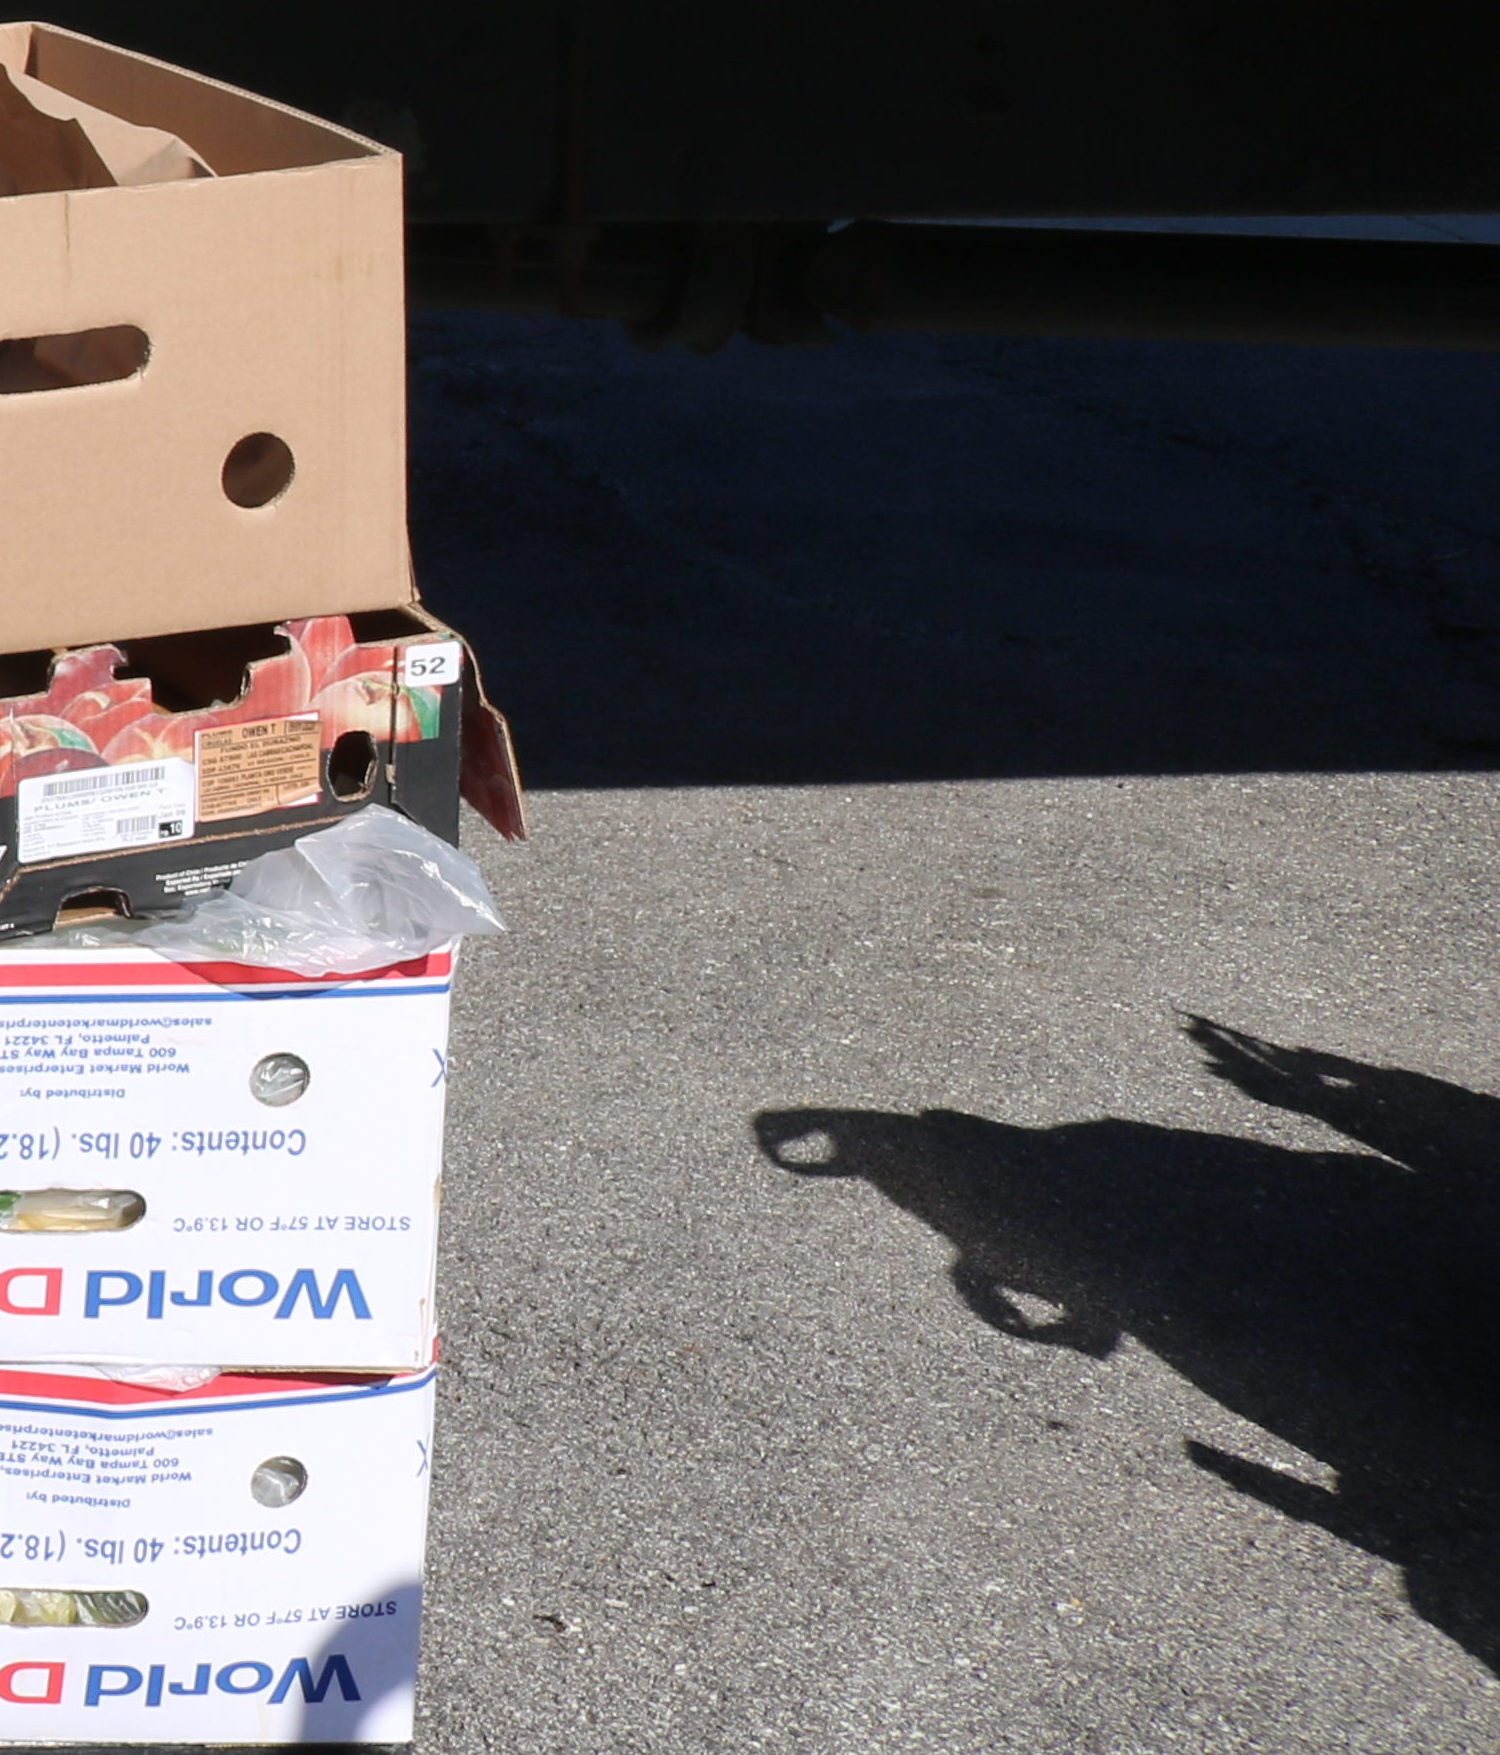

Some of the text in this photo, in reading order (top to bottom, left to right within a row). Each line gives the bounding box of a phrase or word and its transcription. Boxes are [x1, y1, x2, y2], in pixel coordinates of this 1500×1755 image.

[410, 655, 447, 678] 52
[241, 725, 268, 739] OWEN
[33, 797, 97, 813] PLUMS/
[100, 791, 151, 804] OWEN
[157, 787, 166, 795] T
[169, 821, 183, 834] 10
[4, 1033, 150, 1045] Palmetto, FL 34221
[25, 1046, 56, 1059] Way
[60, 1046, 89, 1058] Bay
[94, 1046, 144, 1058] Tampa
[148, 1047, 177, 1058] 600
[90, 1063, 142, 1074] Market
[147, 1062, 190, 1074] World
[19, 1087, 126, 1100] Distributed by:
[72, 1132, 120, 1160] lbs.
[130, 1131, 163, 1159] 40
[171, 1128, 307, 1157] Contents:
[172, 1216, 412, 1233] STORE AT 57°F OR 13.9°C
[83, 1268, 373, 1320] World
[11, 1440, 155, 1458] Palmetto, FL 34221
[30, 1452, 62, 1467] Way
[67, 1455, 95, 1469] Bay
[100, 1458, 148, 1471] Tampa
[152, 1457, 180, 1469] 600
[0, 1466, 91, 1484] Enterprises,
[96, 1474, 147, 1485] Market
[151, 1471, 193, 1484] World
[26, 1490, 131, 1508] Distributed by:
[0, 1530, 66, 1562] (18.2
[76, 1537, 125, 1565] lbs.
[133, 1537, 165, 1563] 40
[173, 1528, 302, 1560] Contents:
[173, 1600, 398, 1631] STORE AT 57°F OR 13.9°C
[82, 1653, 363, 1707] World
